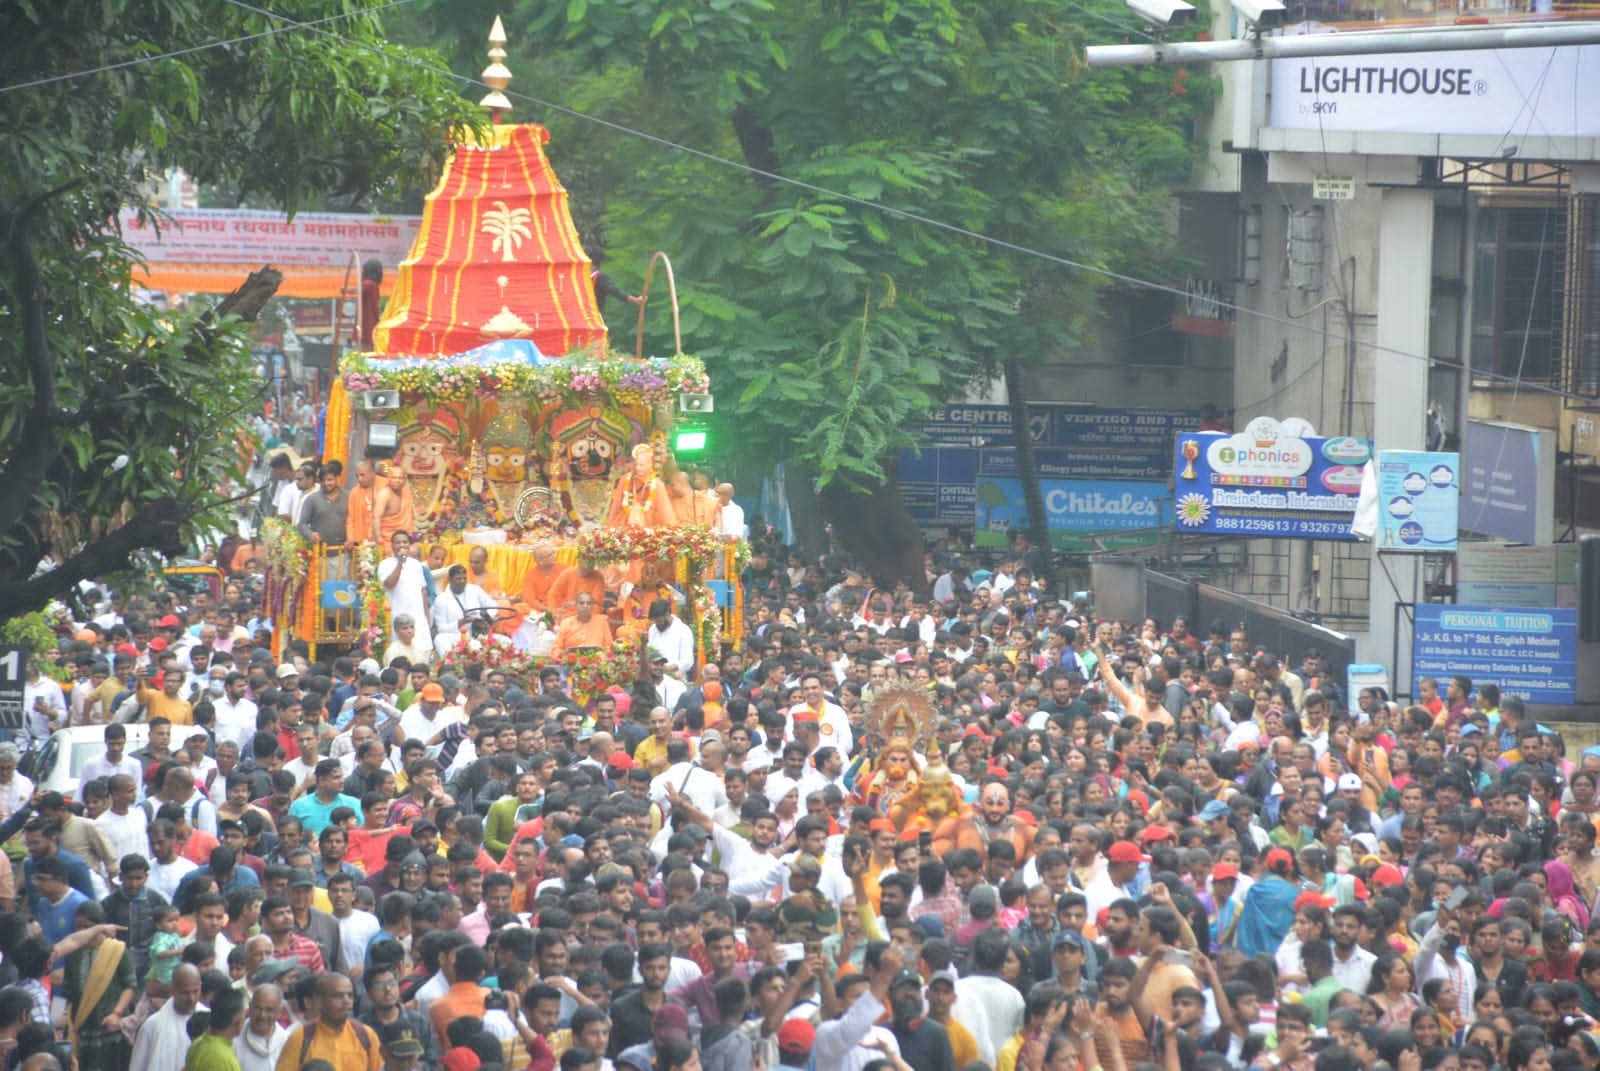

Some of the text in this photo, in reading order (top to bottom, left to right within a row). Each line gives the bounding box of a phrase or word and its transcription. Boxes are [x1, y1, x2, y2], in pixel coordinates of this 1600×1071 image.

[950, 409, 1012, 422] CENTR
[1046, 489, 1157, 516] Chitale's
[1444, 613, 1549, 629] PERSONAL TUITION
[1494, 635, 1525, 647] English
[1527, 636, 1560, 646] Medium
